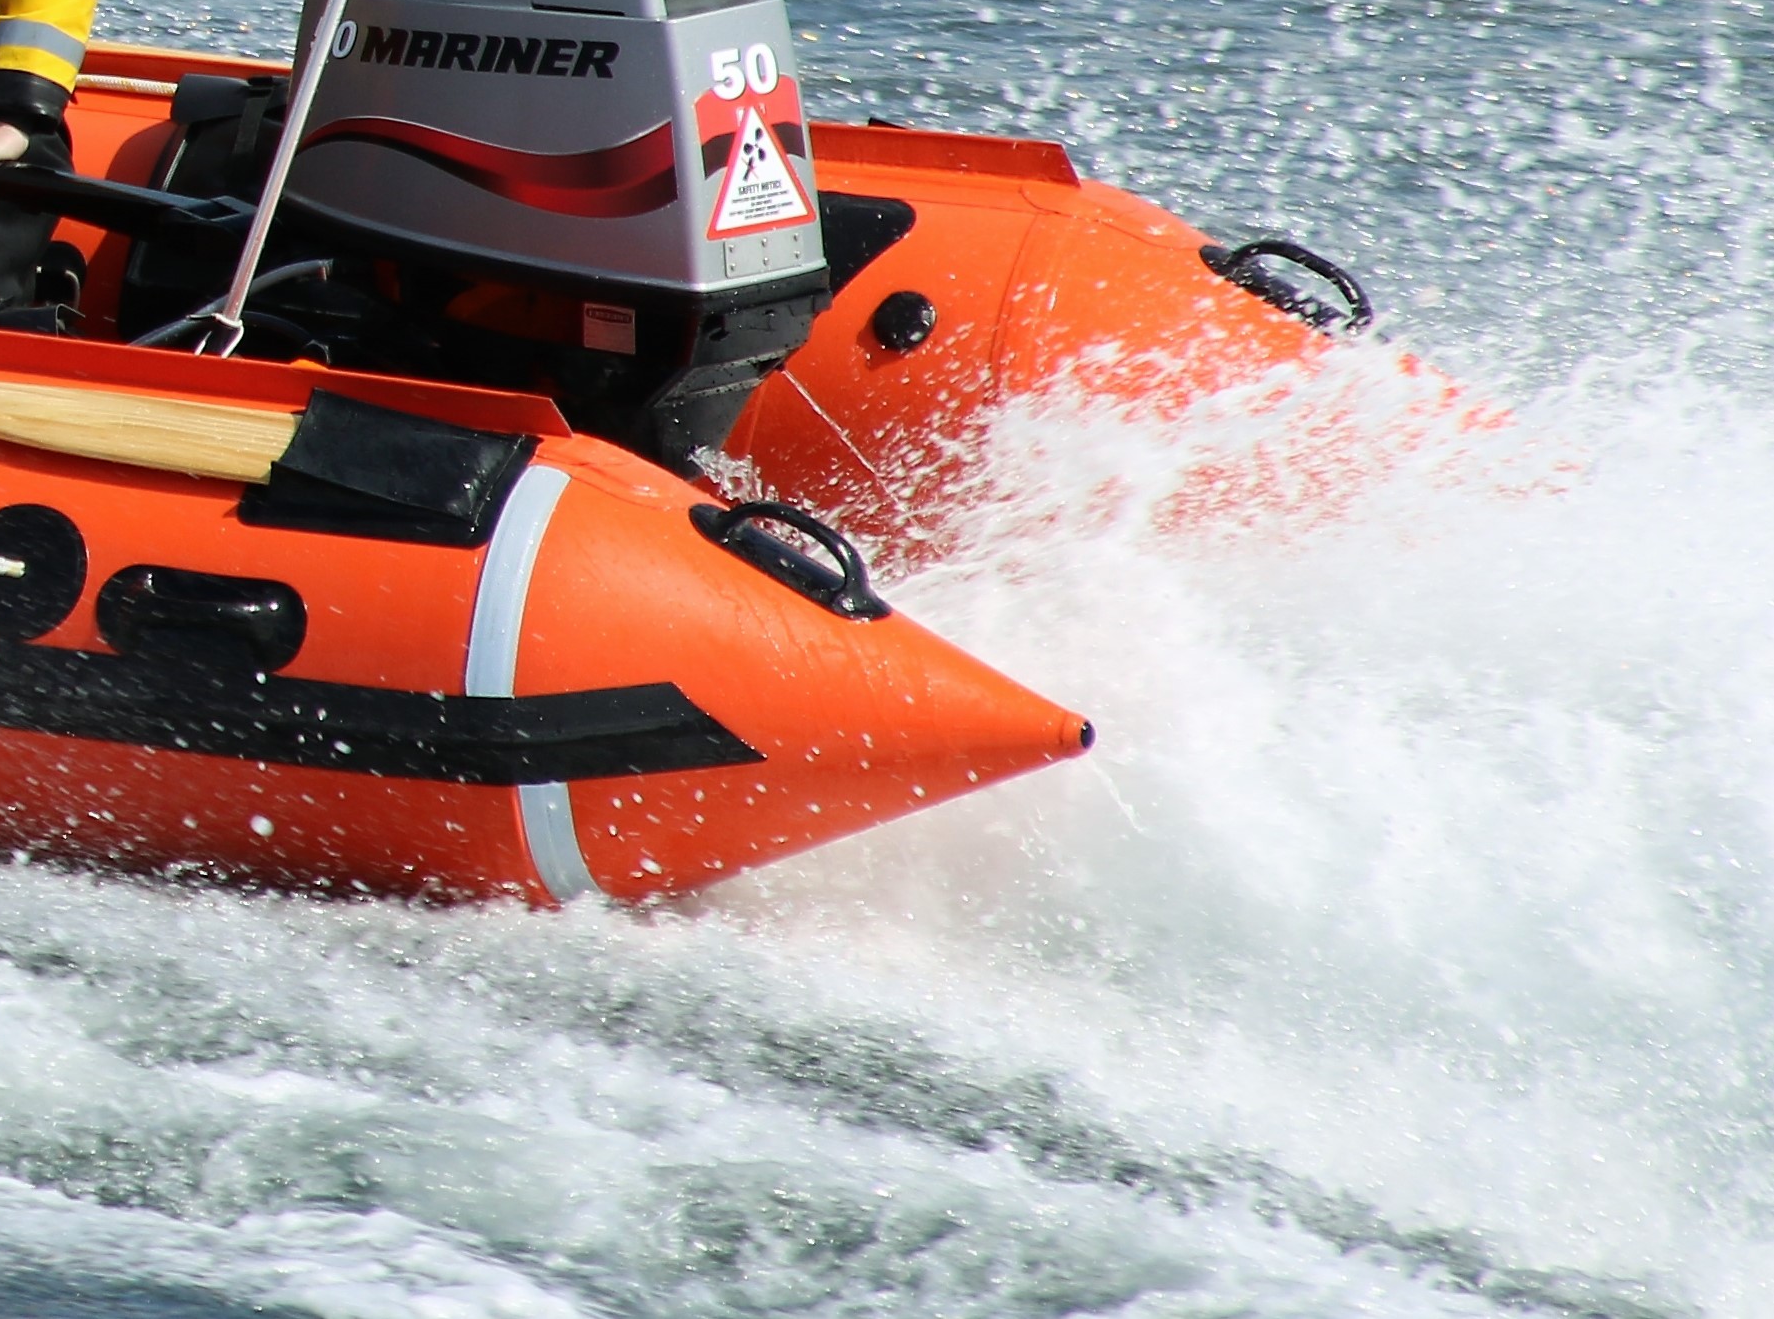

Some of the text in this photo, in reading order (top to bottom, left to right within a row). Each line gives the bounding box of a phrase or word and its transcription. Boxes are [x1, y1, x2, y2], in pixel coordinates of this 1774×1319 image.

[359, 25, 621, 80] MARINER
[710, 42, 779, 101] 50
[738, 183, 760, 195] SAFETY
